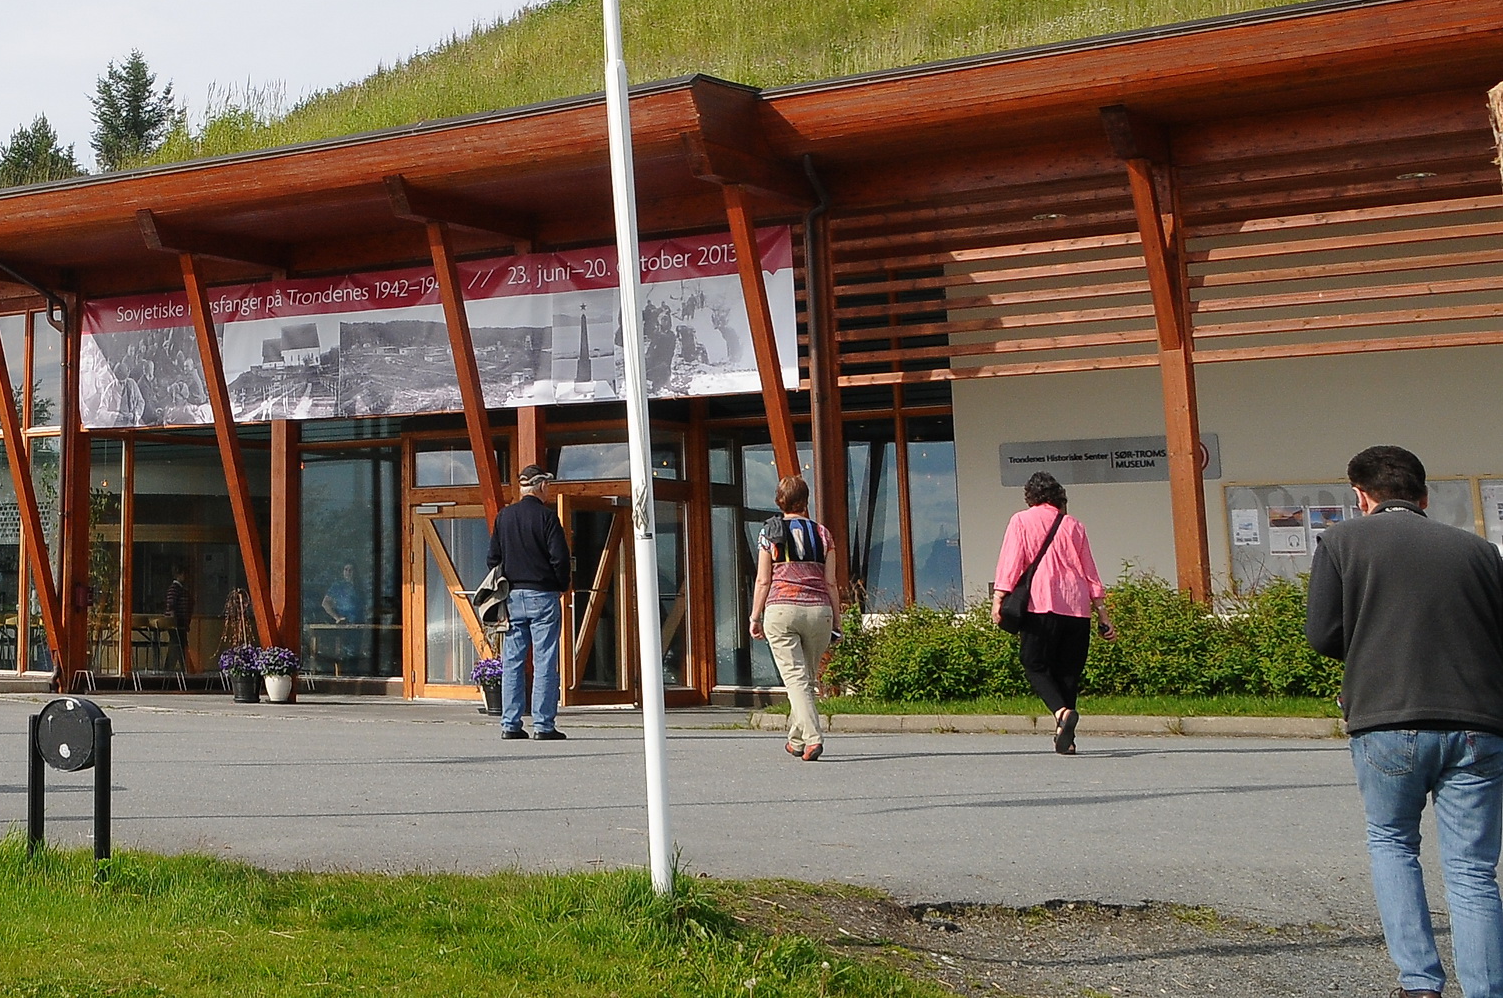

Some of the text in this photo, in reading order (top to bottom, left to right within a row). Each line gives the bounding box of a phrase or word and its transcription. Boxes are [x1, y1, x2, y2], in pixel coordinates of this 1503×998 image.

[116, 300, 184, 324] Sovjetiske
[266, 289, 283, 313] på
[287, 284, 369, 306] Trondenes
[507, 265, 531, 285] 23.
[617, 249, 692, 273] tober
[697, 243, 737, 266] 2013
[1008, 452, 1109, 464] Trondenes Historiske Senter
[1114, 449, 1167, 460] SØR-TROMS
[1115, 458, 1156, 469] MUSEUM
